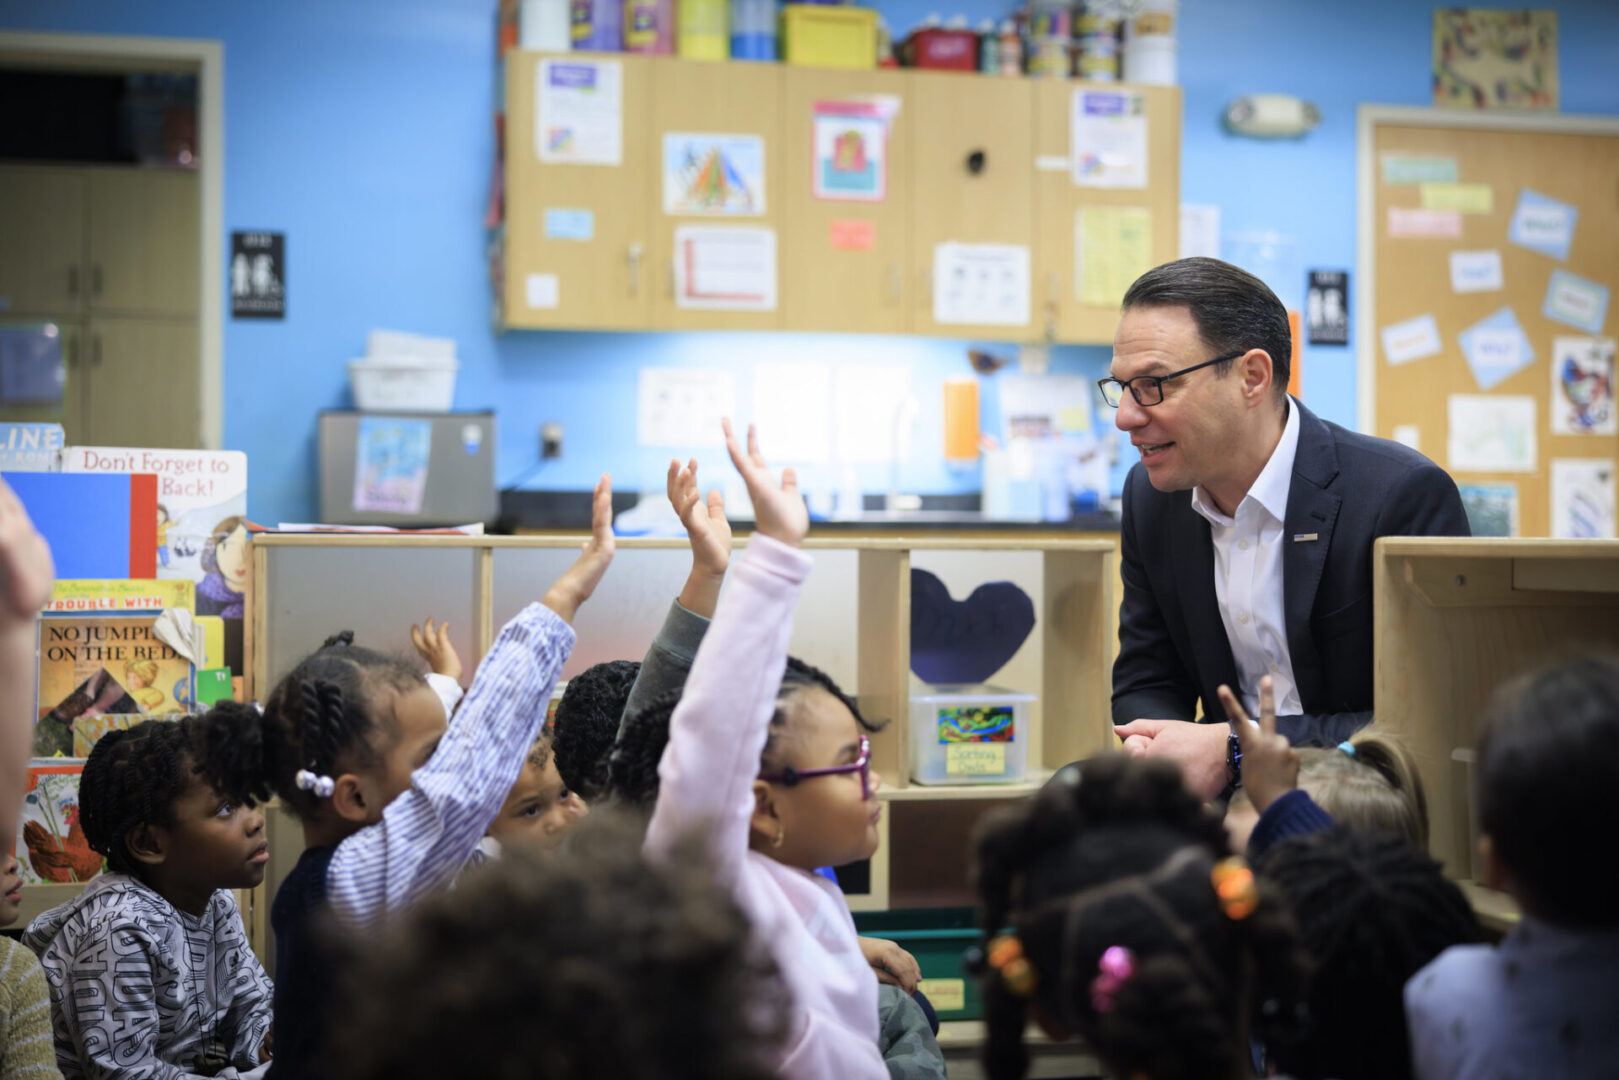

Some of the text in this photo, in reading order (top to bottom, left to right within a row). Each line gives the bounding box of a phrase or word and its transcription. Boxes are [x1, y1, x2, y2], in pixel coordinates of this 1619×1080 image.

[83, 450, 229, 475] Don't Forget to
[162, 477, 214, 497] Back!
[47, 597, 163, 610] TROUBLE WITH
[49, 626, 157, 645] NO JUMPI
[48, 646, 77, 661] ON
[80, 646, 127, 660] THE
